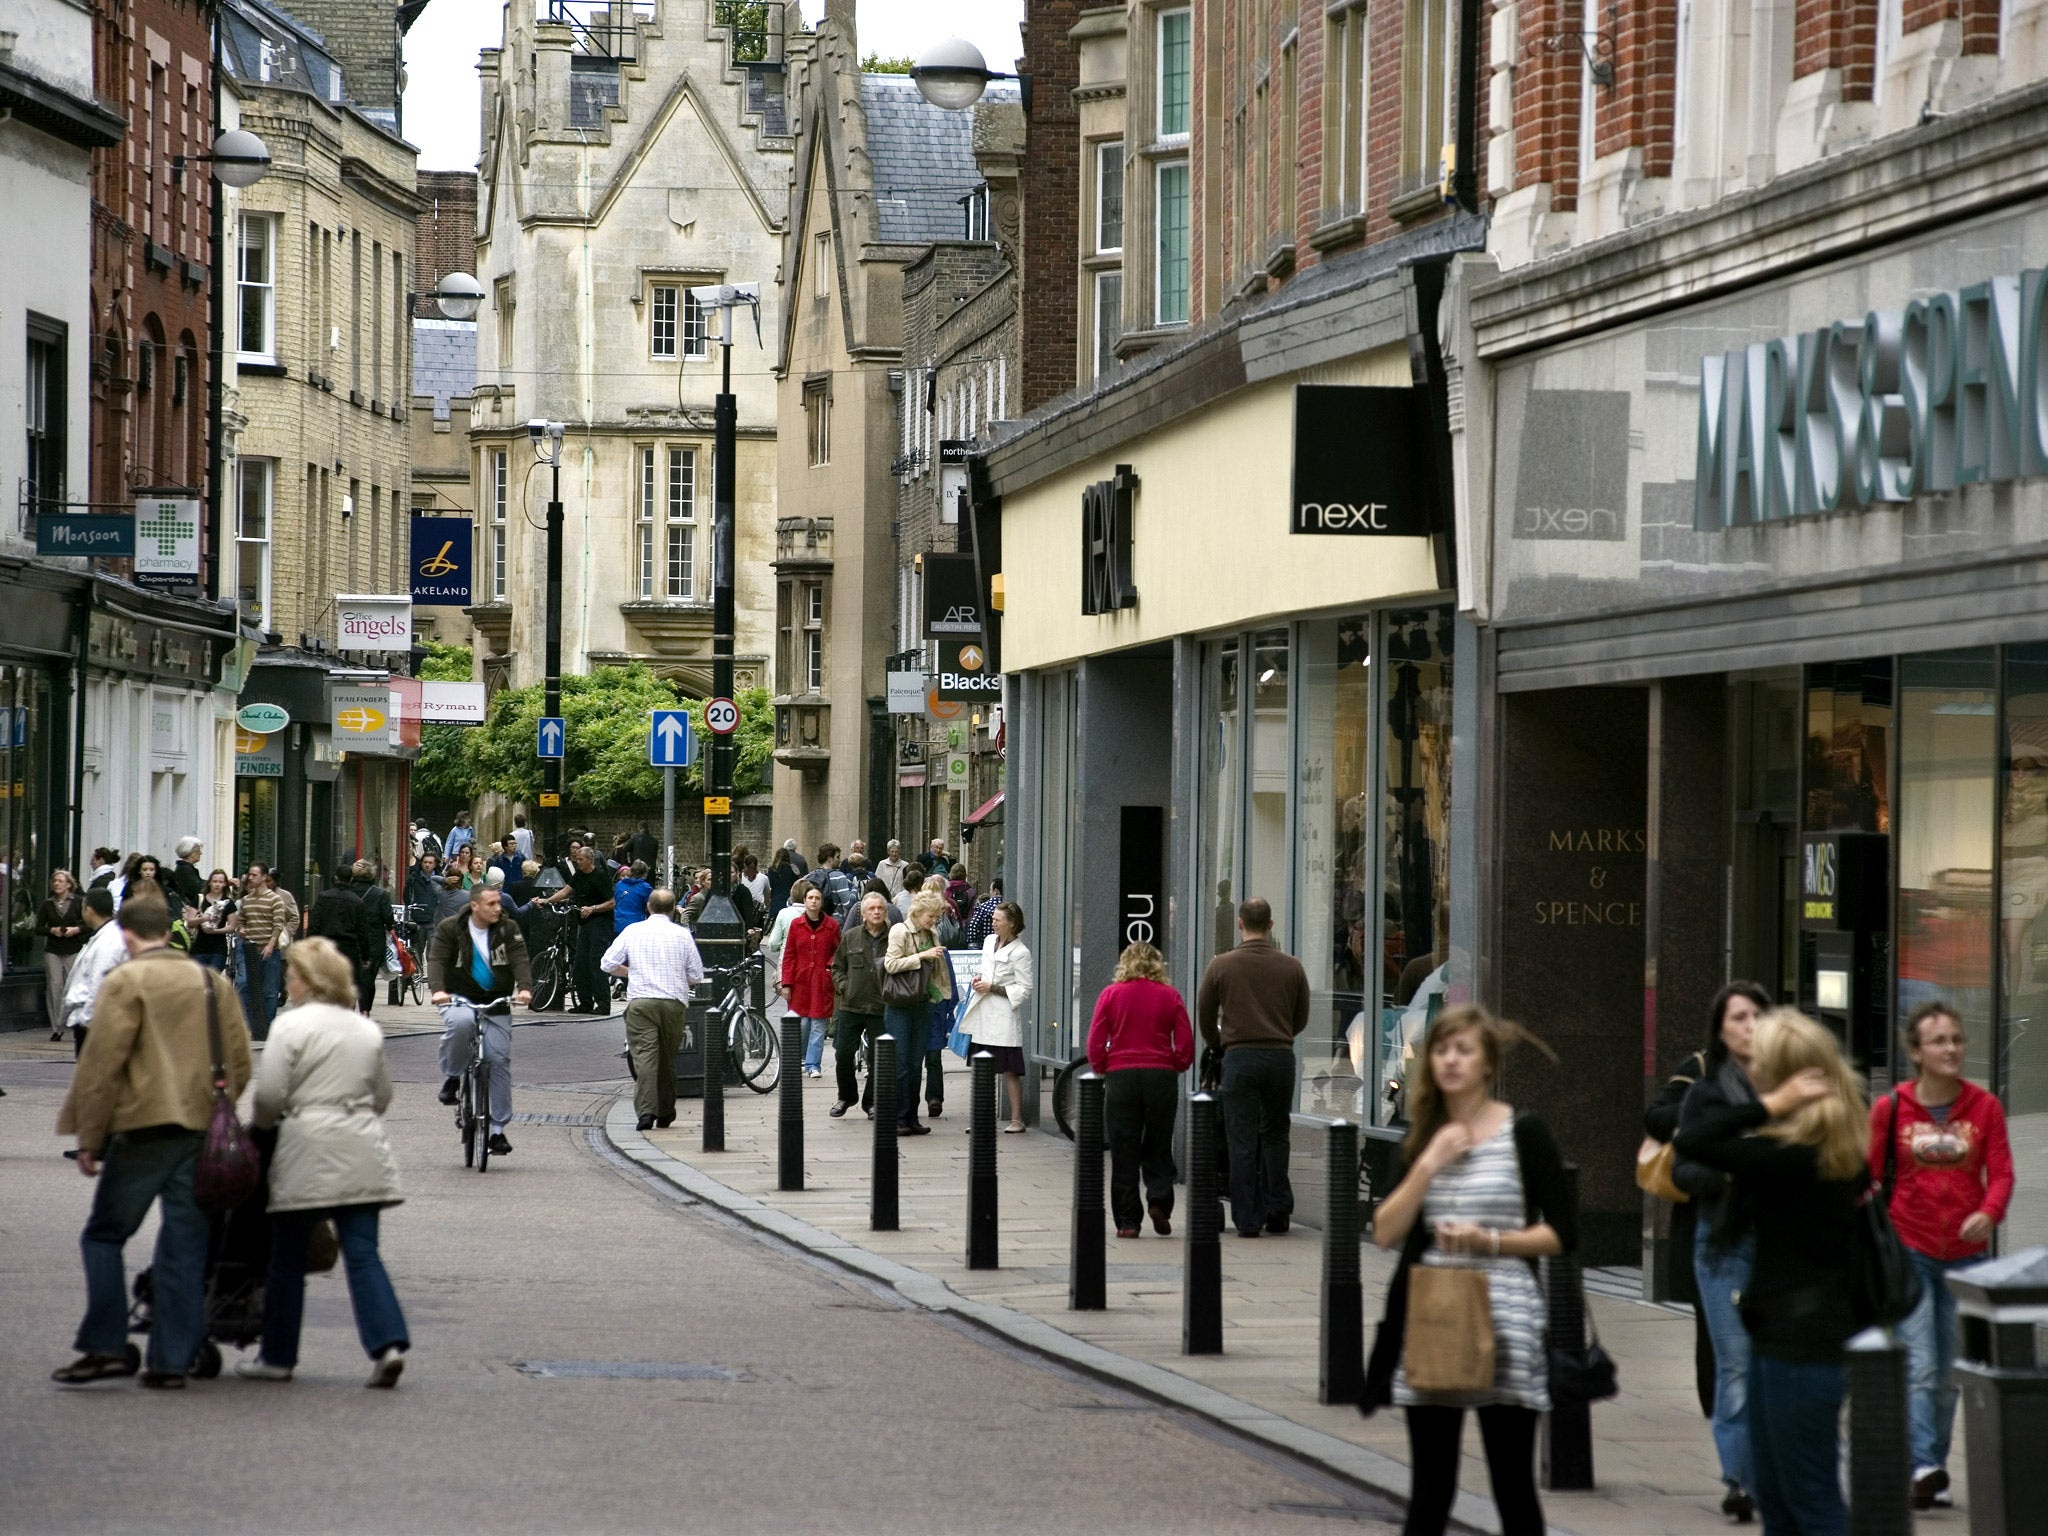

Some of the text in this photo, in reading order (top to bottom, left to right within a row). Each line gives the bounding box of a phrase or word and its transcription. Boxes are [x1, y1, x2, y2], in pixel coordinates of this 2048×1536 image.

[1301, 502, 1388, 530] next
[52, 525, 120, 545] Monsoon
[139, 556, 193, 569] pharmacy
[138, 574, 194, 585] Superdrug
[343, 612, 372, 620] Office
[344, 615, 406, 640] angels
[940, 672, 1000, 690] Blacks
[424, 702, 478, 711] Ryman
[709, 707, 735, 723] 20
[1550, 829, 1647, 852] MARKS
[1590, 866, 1607, 889] &
[1535, 901, 1641, 925] SPENCE
